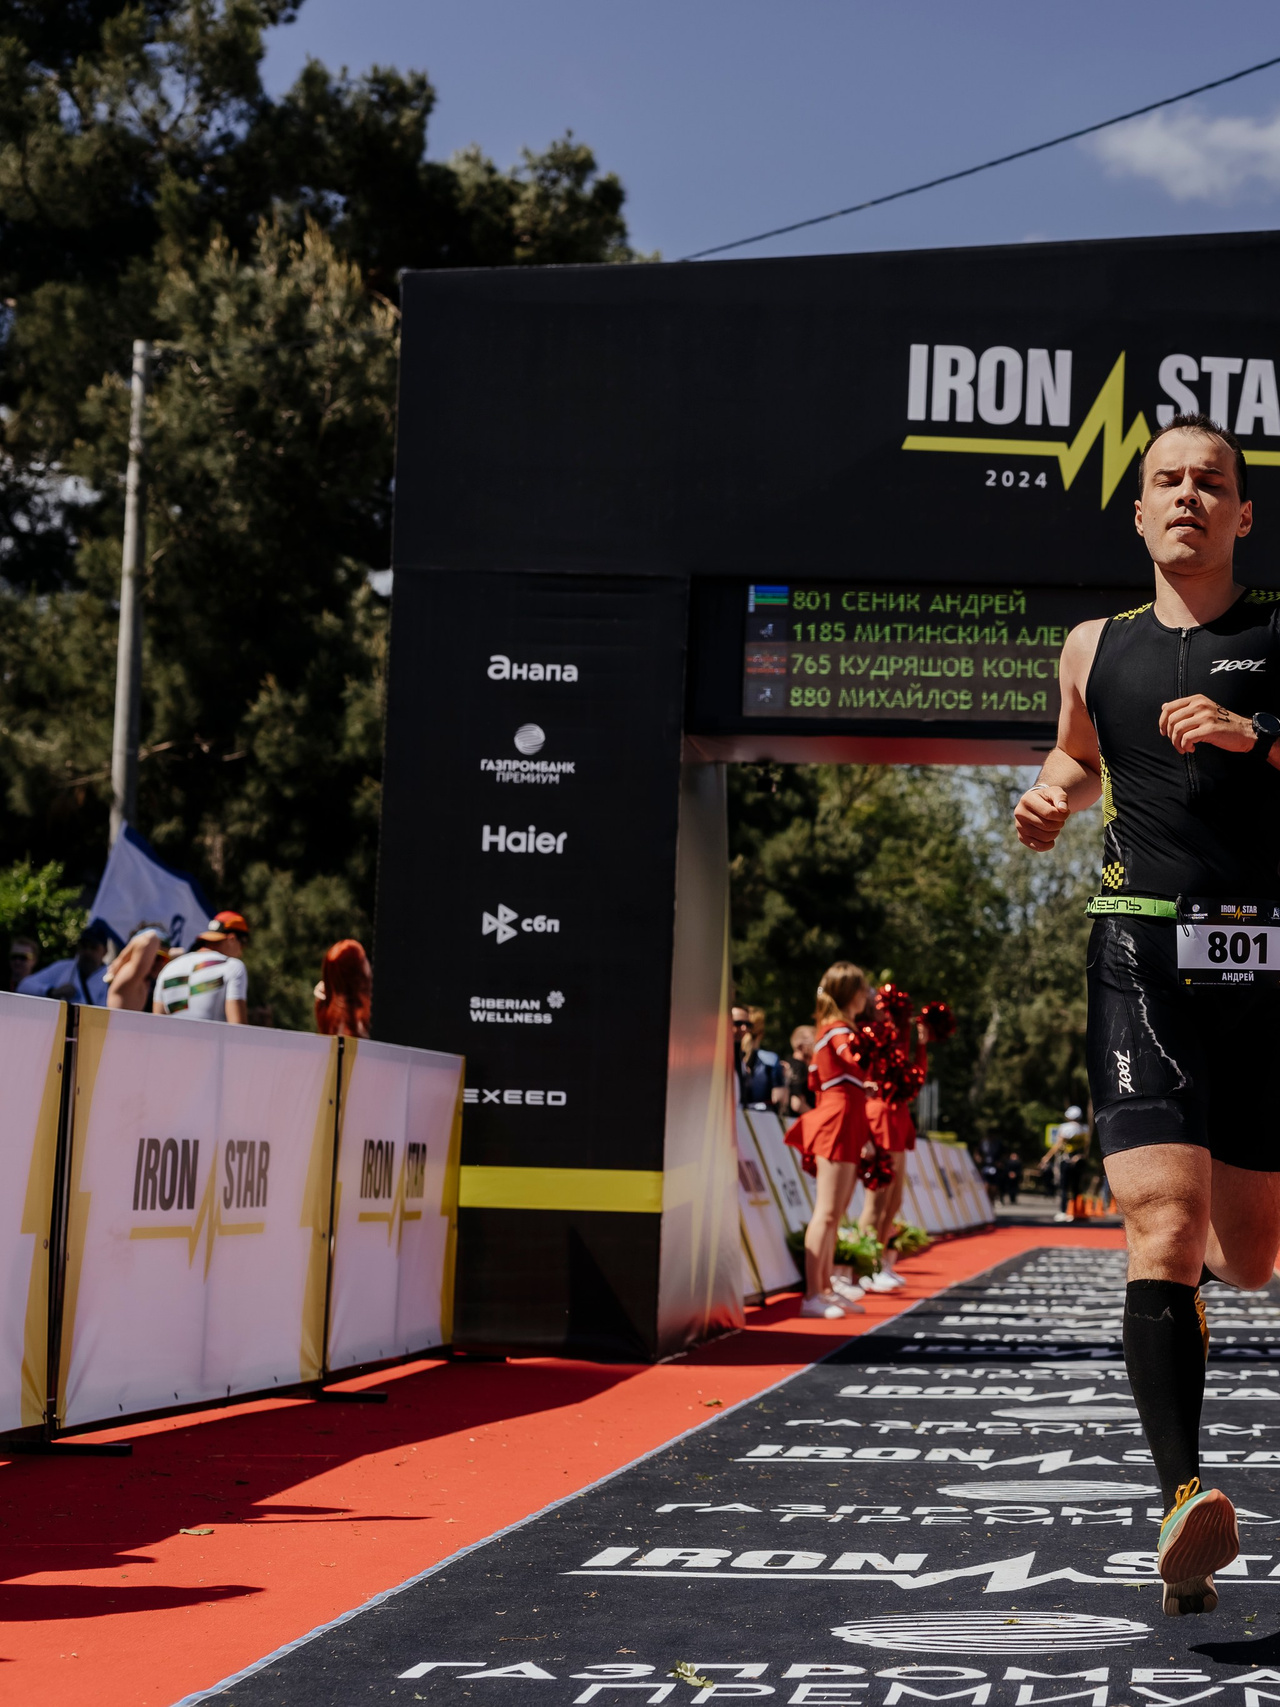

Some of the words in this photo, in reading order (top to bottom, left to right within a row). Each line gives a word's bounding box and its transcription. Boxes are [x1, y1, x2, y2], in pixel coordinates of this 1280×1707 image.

[907, 344, 1073, 427] IRON
[985, 470, 1048, 488] 2024
[792, 591, 831, 611] 801
[841, 591, 921, 612] СЕНИК
[929, 589, 1026, 618] АНДРЕЙ
[792, 622, 846, 642] 1185
[854, 620, 1008, 646] МИТИНСКИЙ
[1016, 626, 1069, 647] АЛЕ
[791, 654, 831, 675] 765
[839, 656, 974, 680] КУДРЯШОВ
[789, 687, 831, 707] 880
[839, 682, 973, 709] МИХАЙЛОВ
[982, 691, 1048, 711] ИЛЬЯ
[480, 759, 576, 774] ГАЗПРОМБАНК
[496, 771, 560, 784] ПРЕМИУМ
[482, 824, 568, 854] Haier
[1220, 904, 1236, 913] IRON
[1242, 905, 1258, 914] STAR
[521, 915, 560, 933] сбп
[1207, 931, 1268, 965] 801
[1221, 971, 1255, 983] АНДРЕЙ
[463, 1088, 567, 1106] EXEED
[132, 1137, 200, 1211] IRON
[223, 1139, 271, 1210] STAR
[360, 1139, 395, 1199] IRON
[839, 1385, 1035, 1396] IRON
[878, 1425, 1262, 1436] ПРЕМИМ
[745, 1444, 995, 1461] IRON
[580, 1546, 929, 1572] IRON
